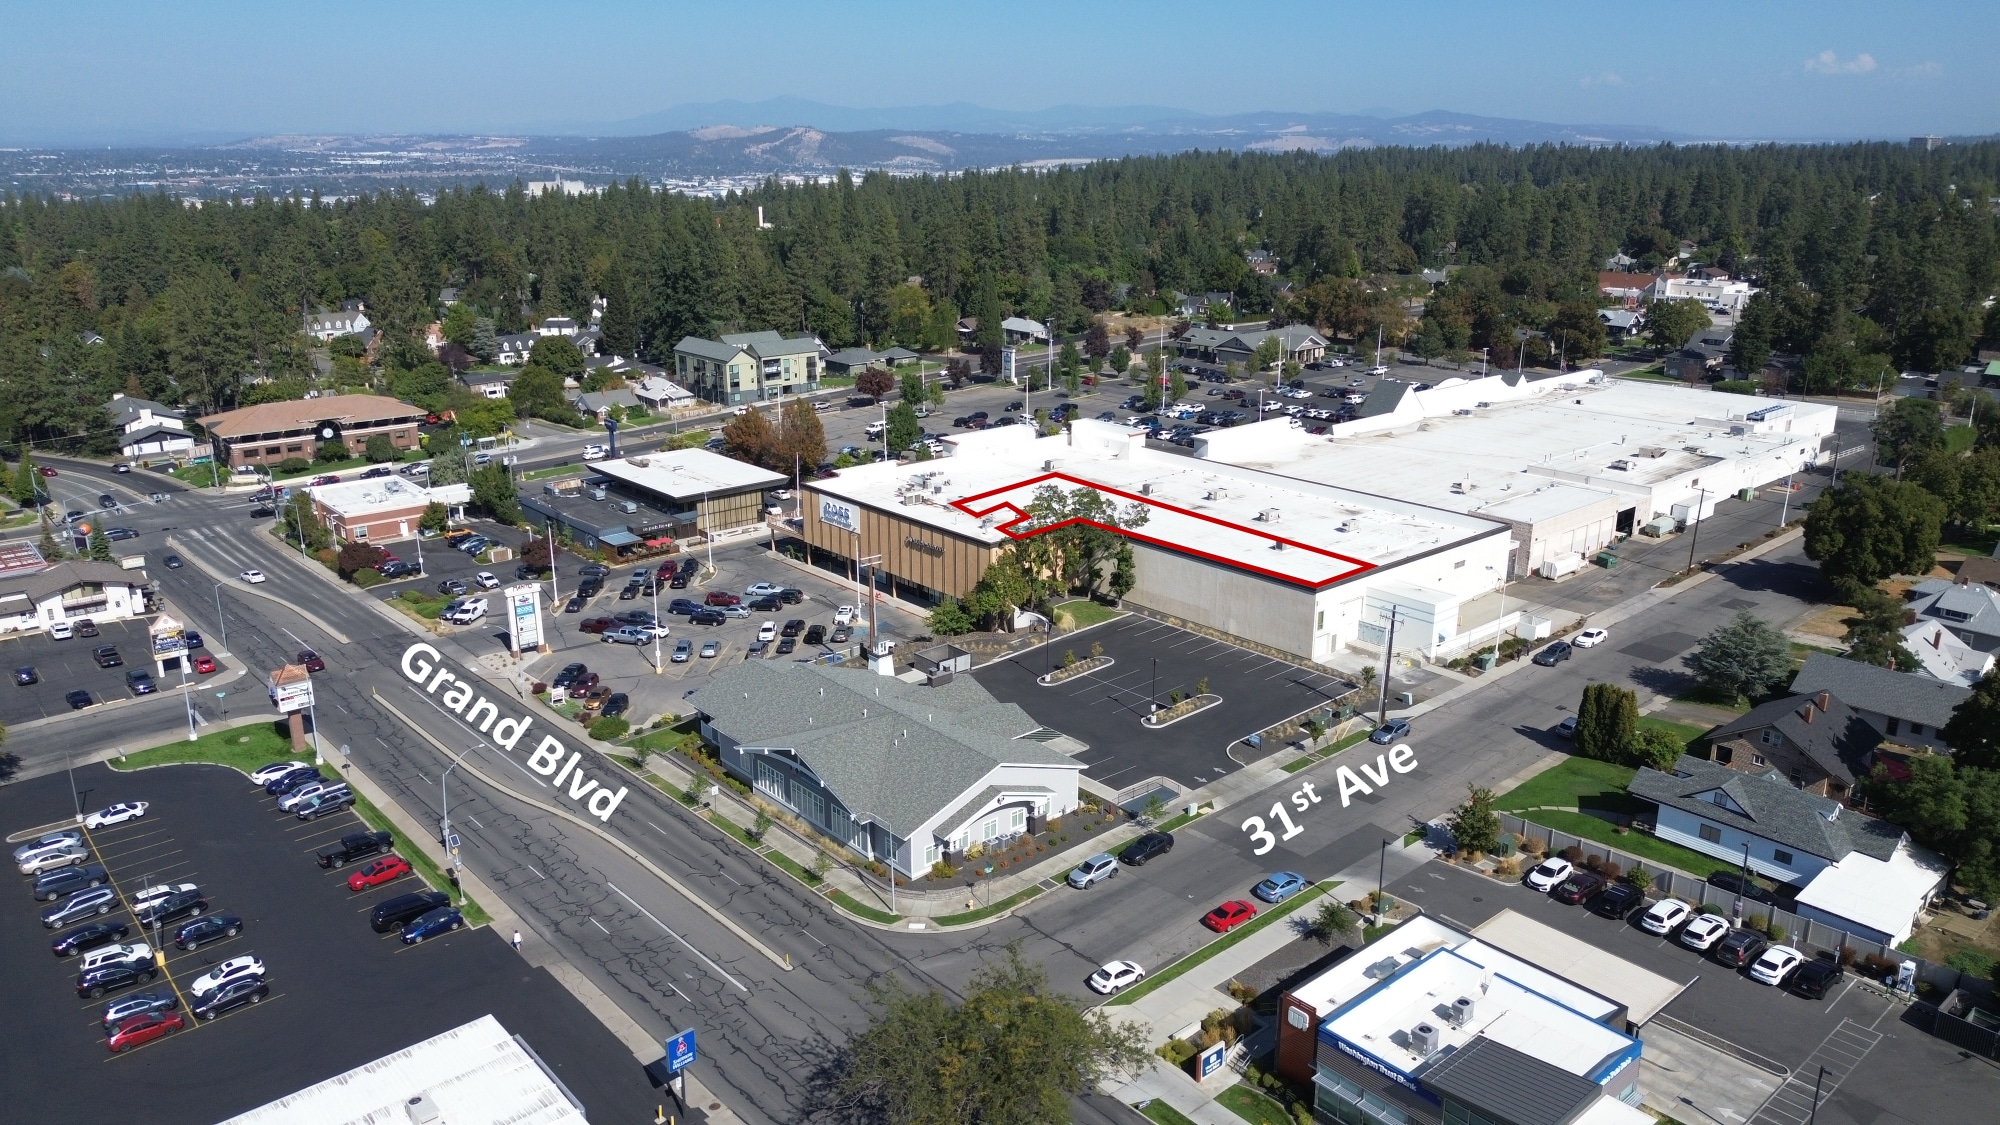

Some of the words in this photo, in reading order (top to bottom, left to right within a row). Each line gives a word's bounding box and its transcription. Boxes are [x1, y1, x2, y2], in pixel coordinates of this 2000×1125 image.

[1337, 1041, 1379, 1070] Washington
[1378, 1063, 1397, 1081] Trust
[1396, 1074, 1417, 1092] Bank
